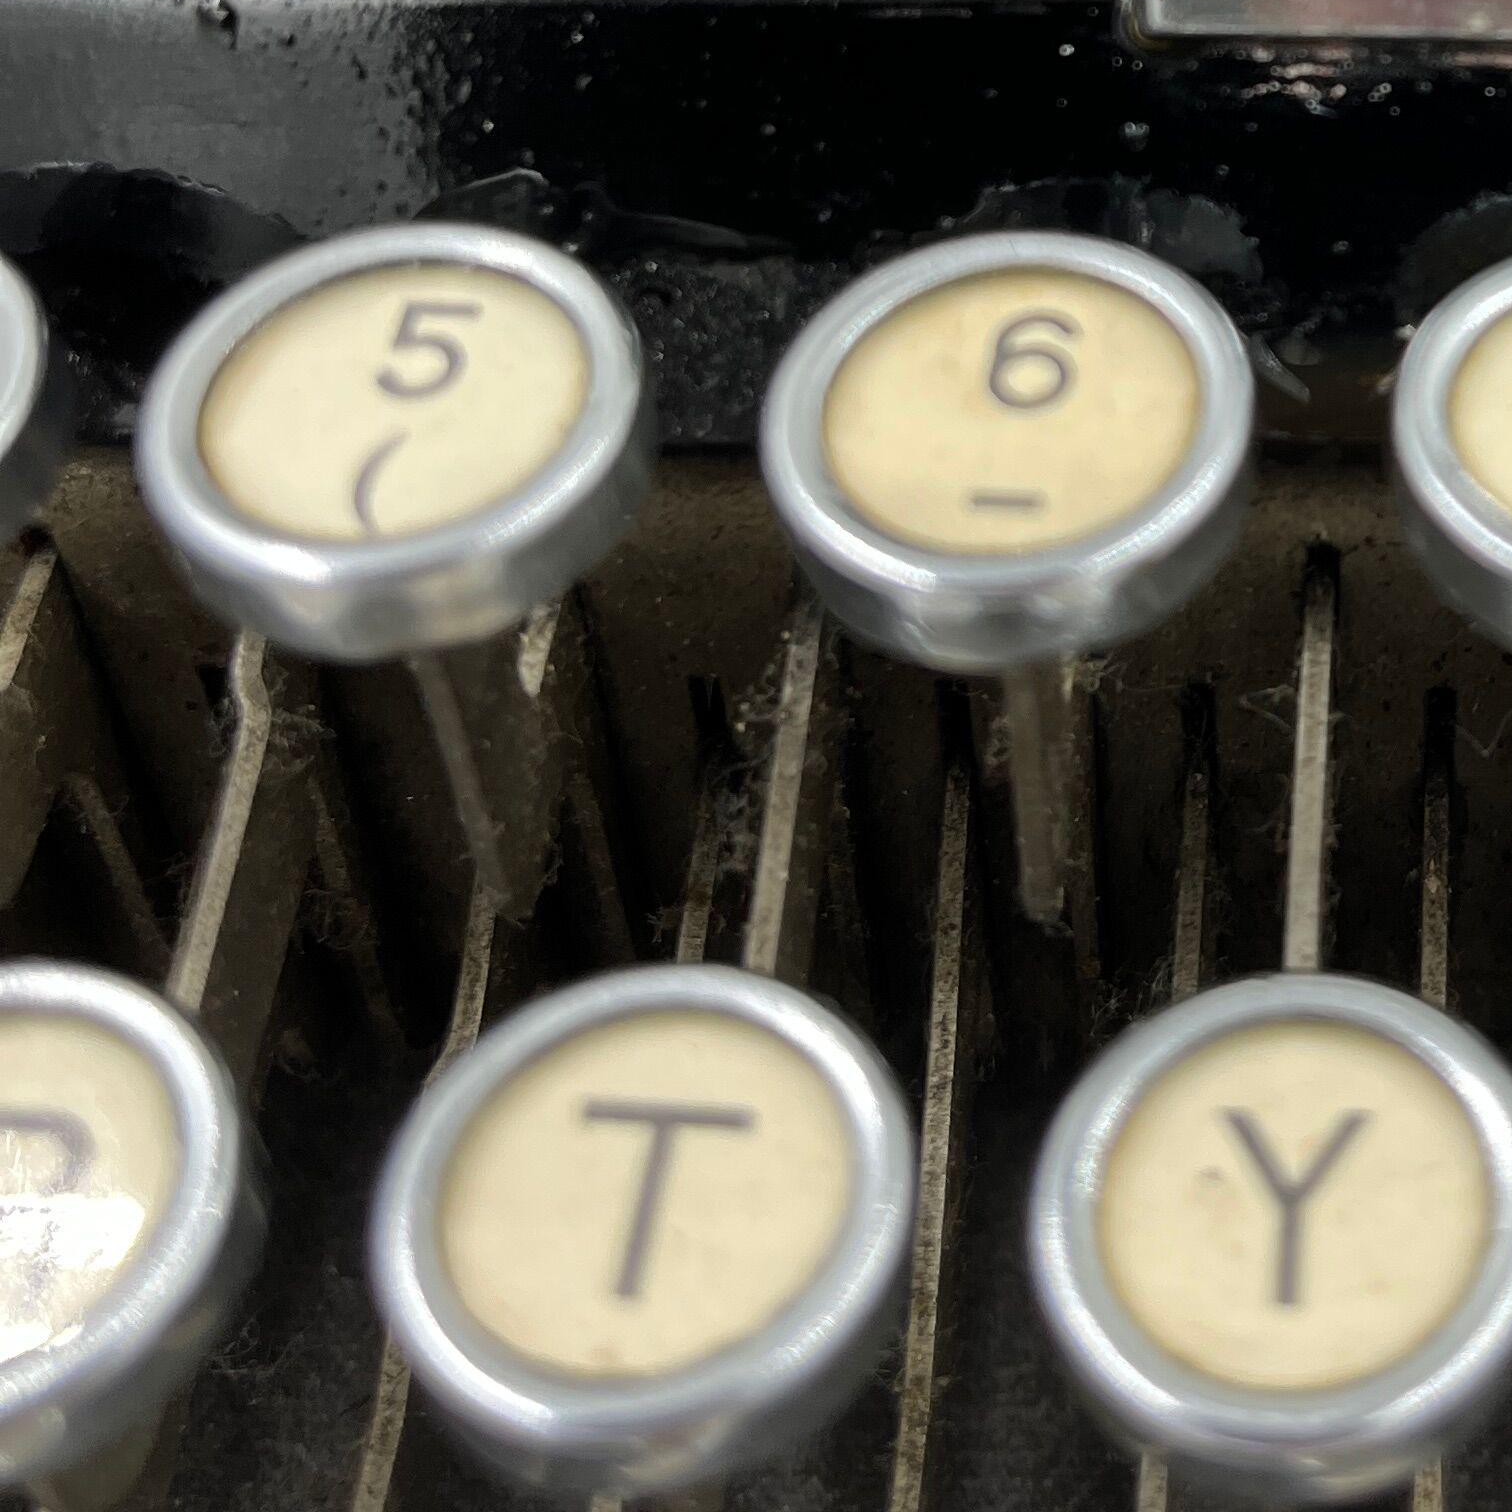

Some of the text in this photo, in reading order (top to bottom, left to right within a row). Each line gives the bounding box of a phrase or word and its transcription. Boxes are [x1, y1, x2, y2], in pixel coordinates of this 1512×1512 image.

[375, 300, 482, 400] 5
[989, 312, 1081, 410] 6
[583, 1097, 757, 1299] T
[1224, 1107, 1371, 1305] Y
